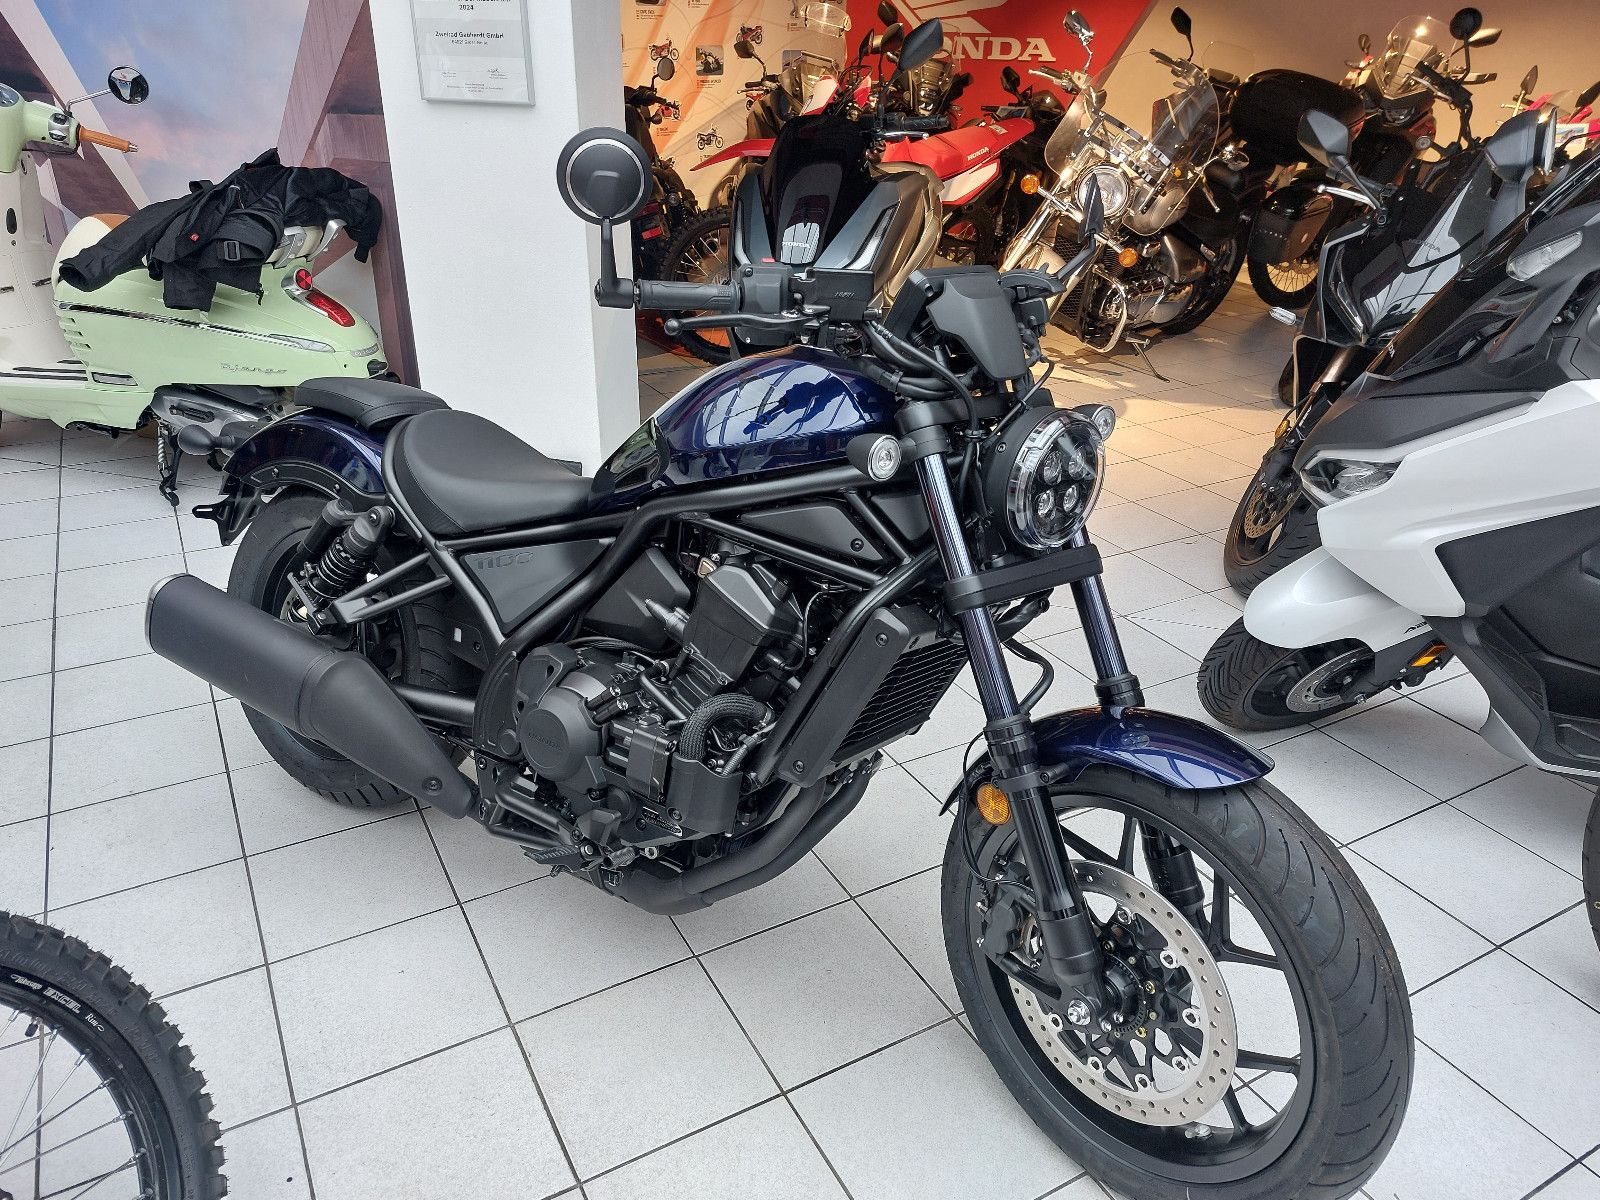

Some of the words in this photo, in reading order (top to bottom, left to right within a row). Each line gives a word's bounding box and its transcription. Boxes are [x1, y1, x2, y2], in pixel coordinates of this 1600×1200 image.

[931, 33, 1057, 62] ONDA
[967, 146, 990, 161] HONDA
[781, 241, 811, 249] HONDA
[43, 986, 82, 1014] EXCEL
